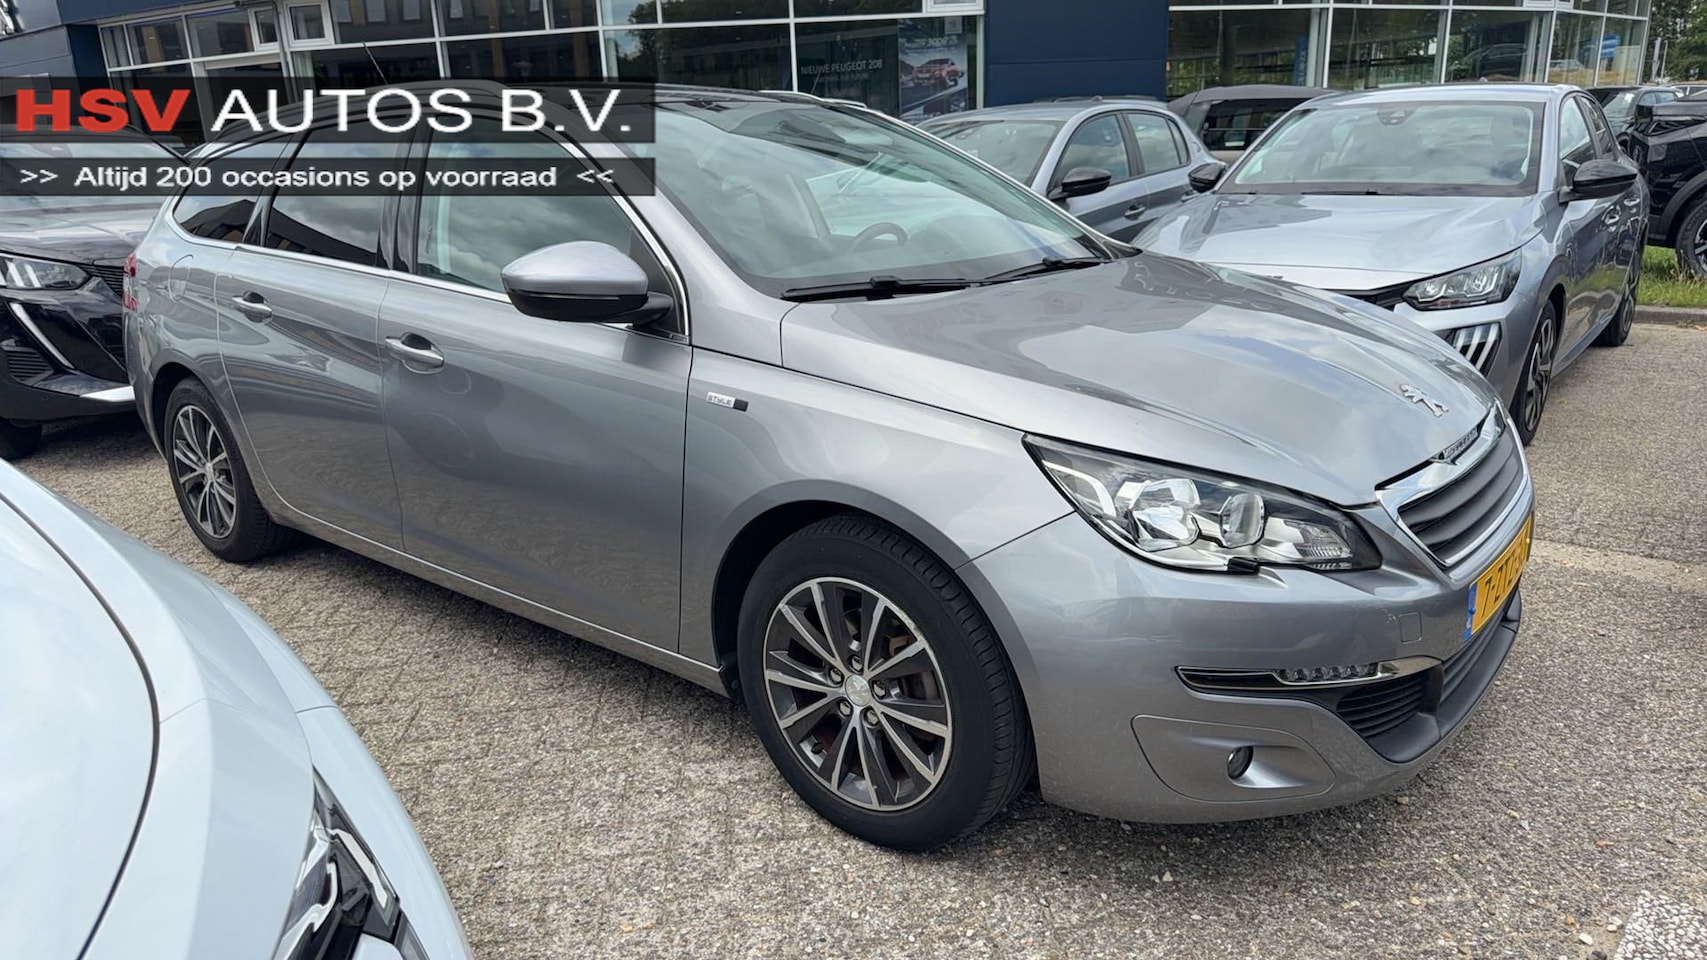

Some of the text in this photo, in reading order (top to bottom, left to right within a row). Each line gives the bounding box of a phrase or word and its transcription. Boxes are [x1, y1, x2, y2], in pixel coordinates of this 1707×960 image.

[800, 59, 883, 75] NIEUWE PEUGEOT 208
[707, 394, 733, 406] STYLE
